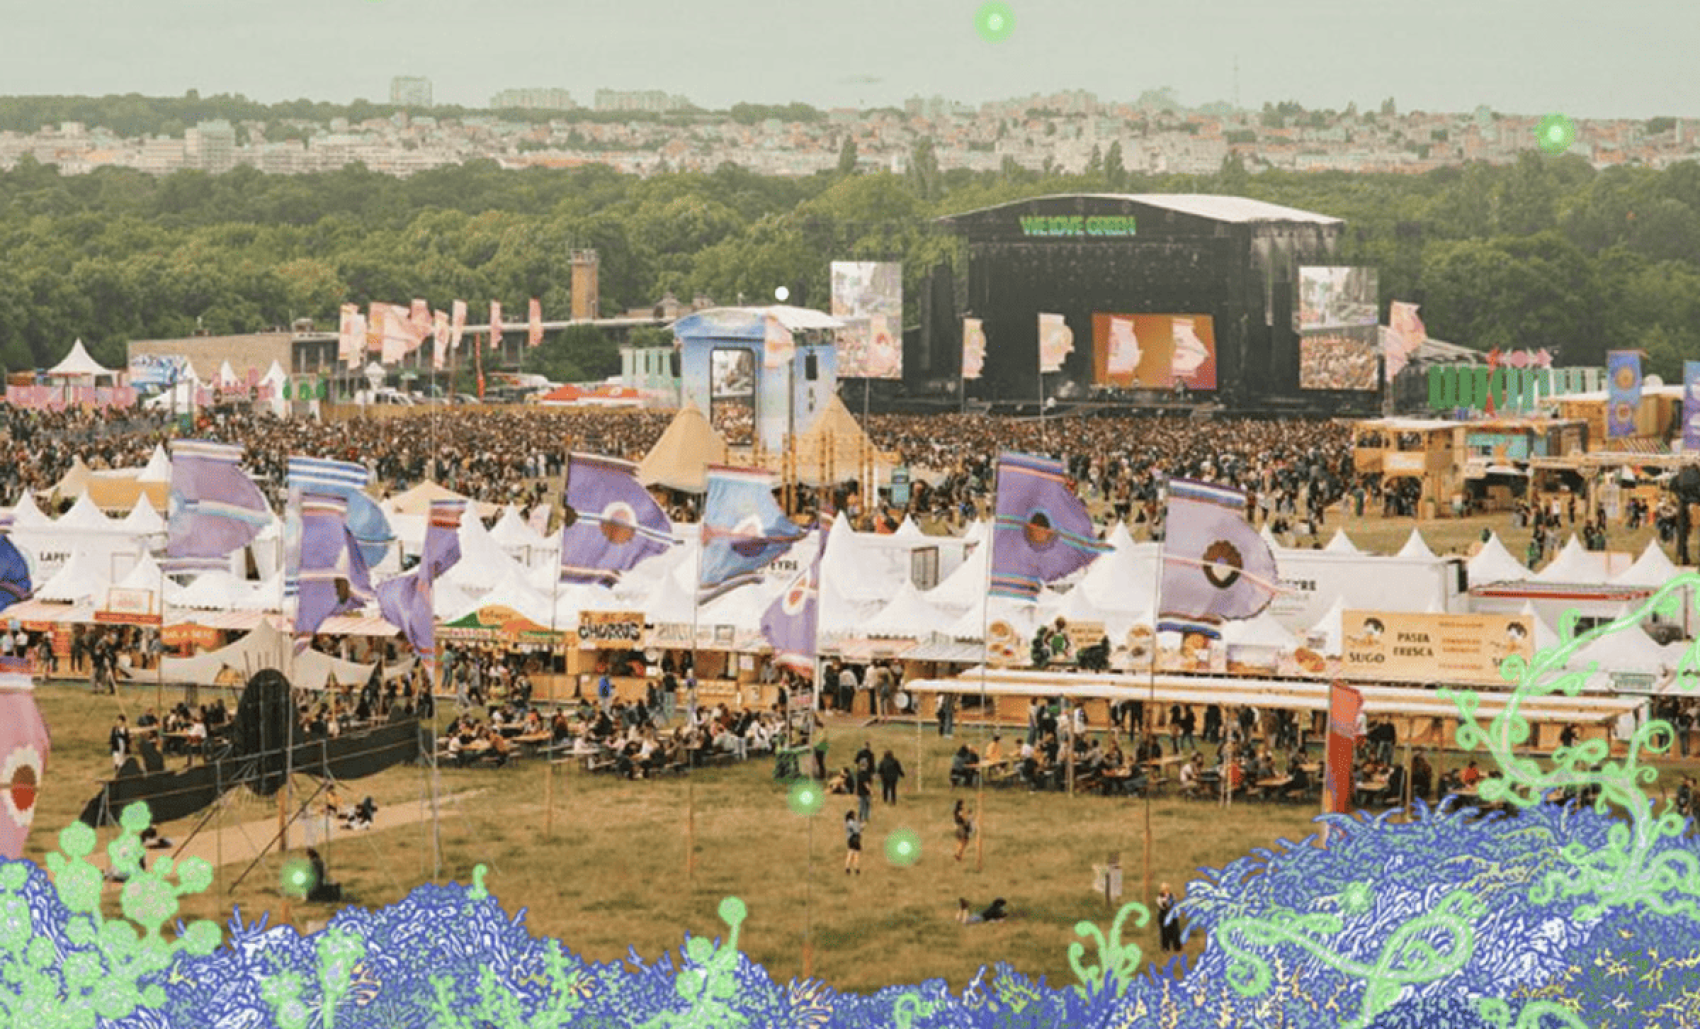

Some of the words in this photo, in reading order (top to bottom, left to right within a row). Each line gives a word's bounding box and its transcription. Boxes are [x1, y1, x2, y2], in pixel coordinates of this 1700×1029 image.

[1020, 215, 1047, 236] WE
[1085, 215, 1136, 236] GREEN
[1349, 651, 1385, 664] SUGO
